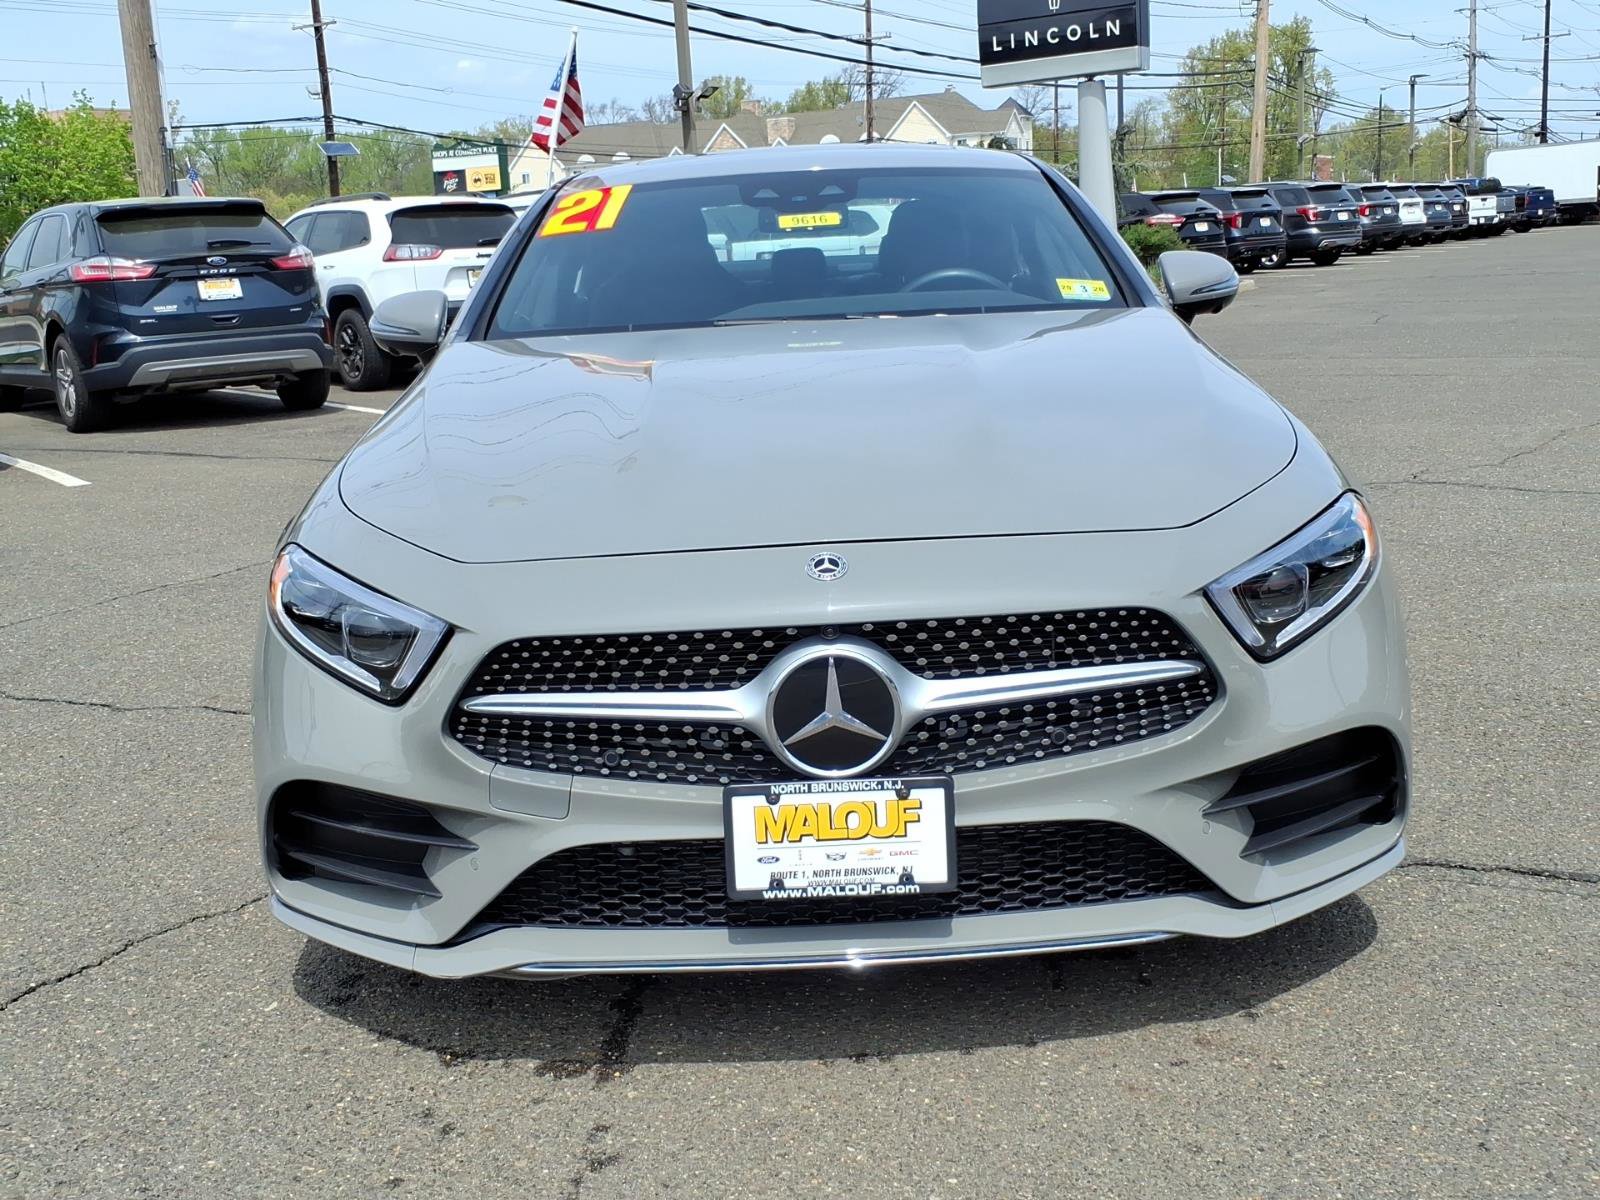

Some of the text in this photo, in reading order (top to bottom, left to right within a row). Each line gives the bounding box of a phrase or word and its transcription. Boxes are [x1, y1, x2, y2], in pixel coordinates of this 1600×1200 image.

[992, 19, 1121, 52] LINCOLN
[539, 183, 634, 237] 21
[791, 214, 828, 226] 9616
[200, 267, 237, 275] EDGE
[770, 782, 809, 795] NORTH
[883, 779, 905, 791] N.J.
[753, 798, 922, 844] MALOUF
[889, 848, 920, 857] GMC
[770, 870, 799, 881] ROUTE
[812, 868, 842, 879] NORTH
[902, 864, 914, 875] NJ
[762, 883, 920, 900] www.MALOUF.com
